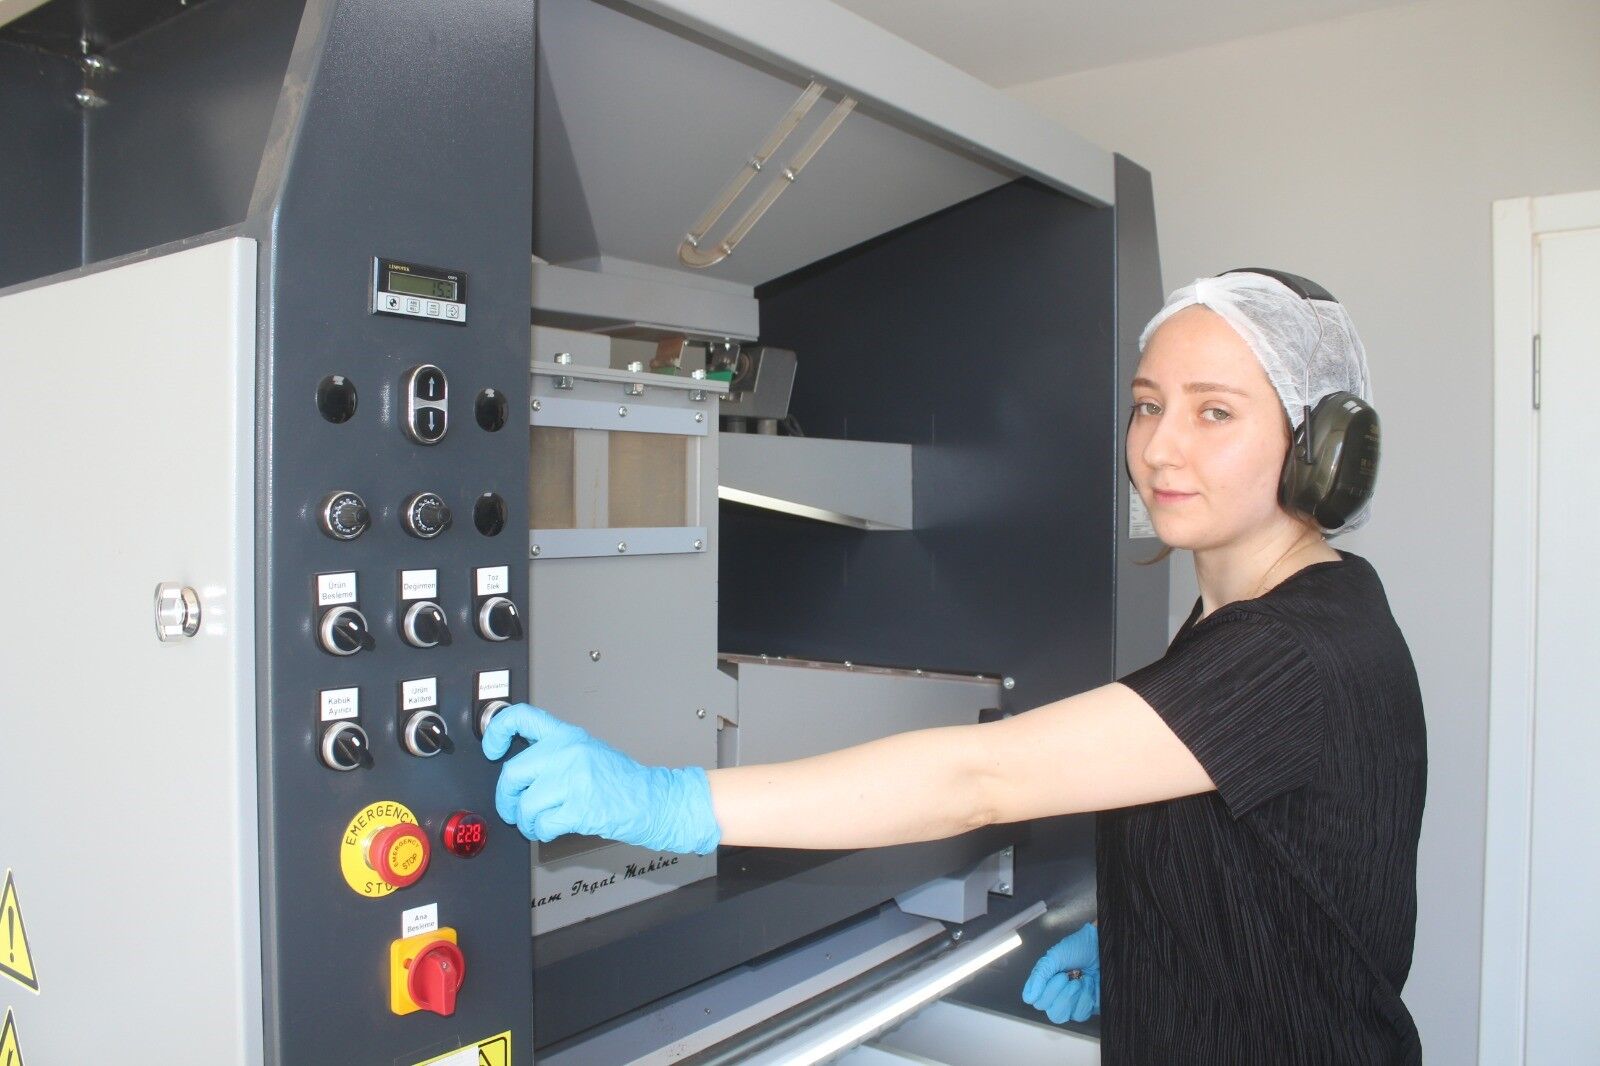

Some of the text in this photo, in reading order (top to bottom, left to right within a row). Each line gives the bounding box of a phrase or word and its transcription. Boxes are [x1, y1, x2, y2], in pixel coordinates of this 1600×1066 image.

[321, 591, 353, 601] Besleme
[327, 696, 351, 705] Kabuk
[456, 824, 481, 844] 228
[392, 838, 420, 868] EMERGENCY
[401, 853, 418, 870] STOP
[407, 921, 435, 933] Besleme
